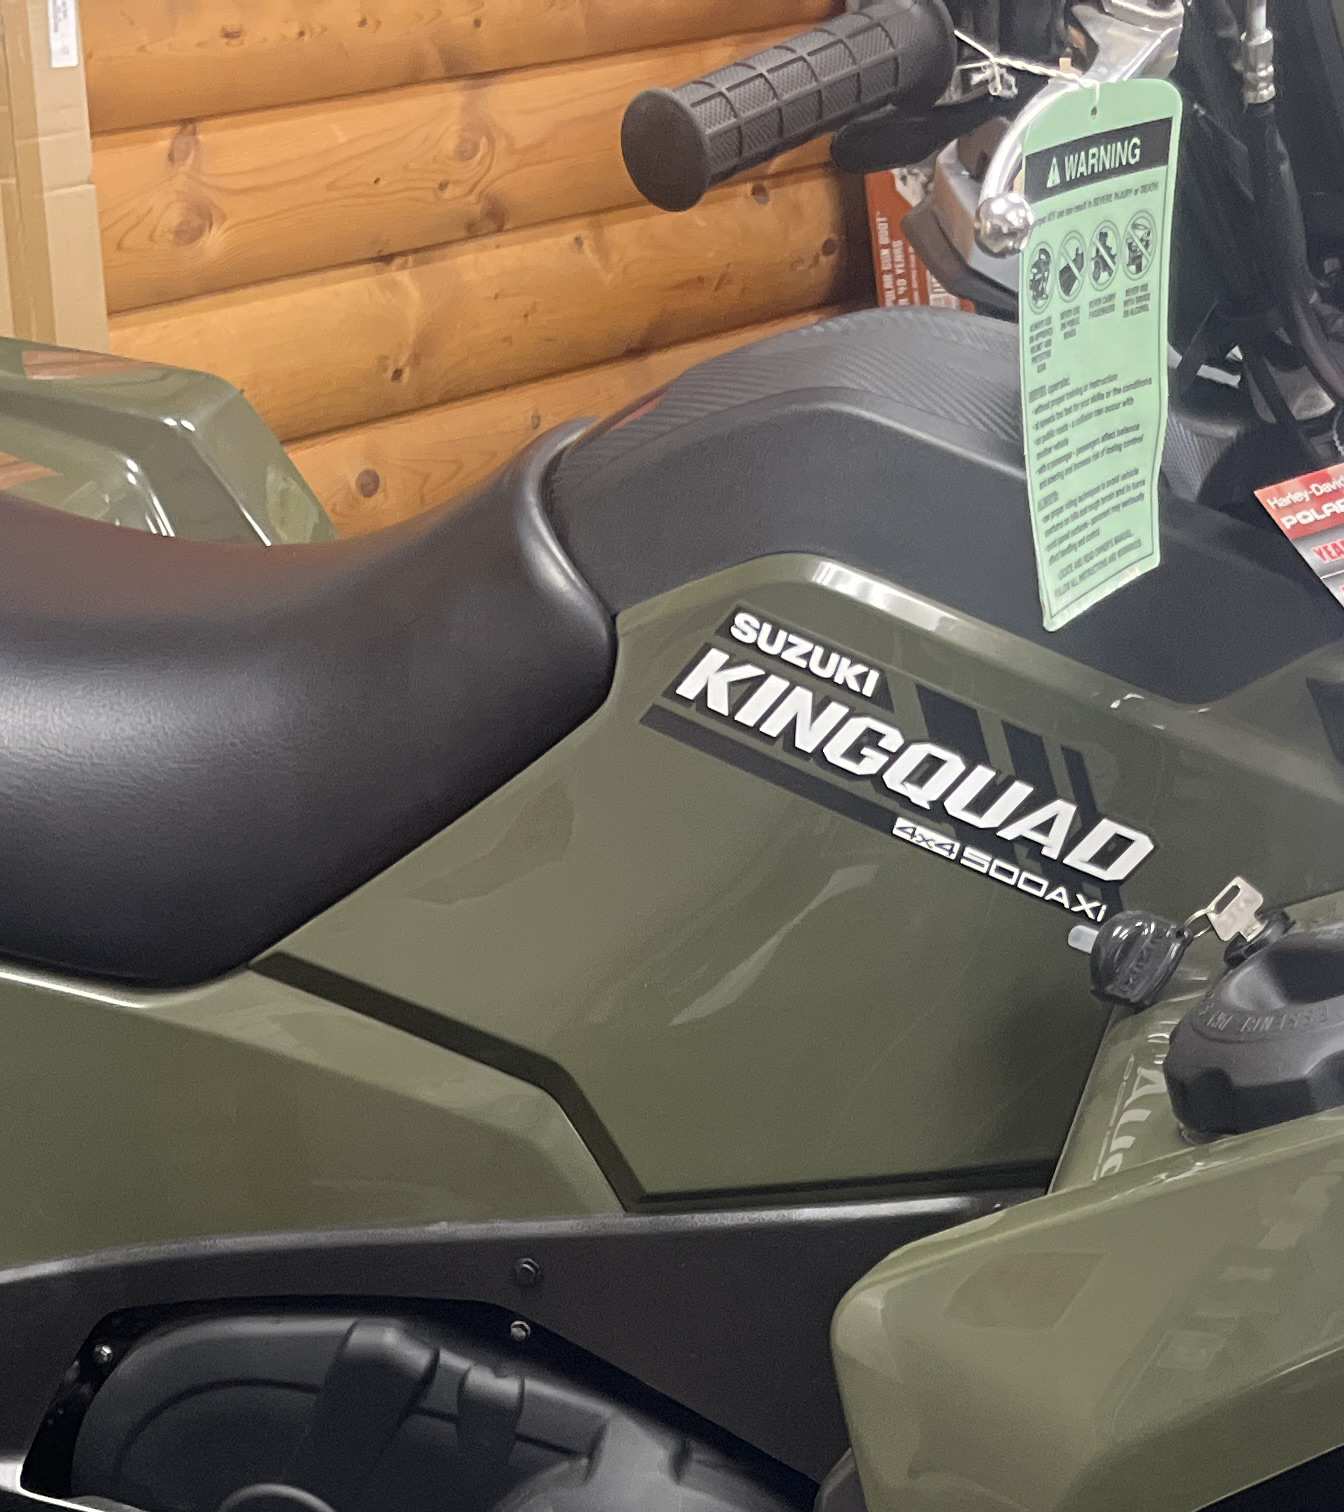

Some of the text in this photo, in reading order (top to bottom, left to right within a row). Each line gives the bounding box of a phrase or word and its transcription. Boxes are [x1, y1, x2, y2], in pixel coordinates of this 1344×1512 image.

[1064, 137, 1142, 181] WARNING
[730, 612, 880, 698] SUZUKI
[675, 646, 1155, 882] KINGQUAD
[894, 819, 1107, 922] 4x4 500AXI
